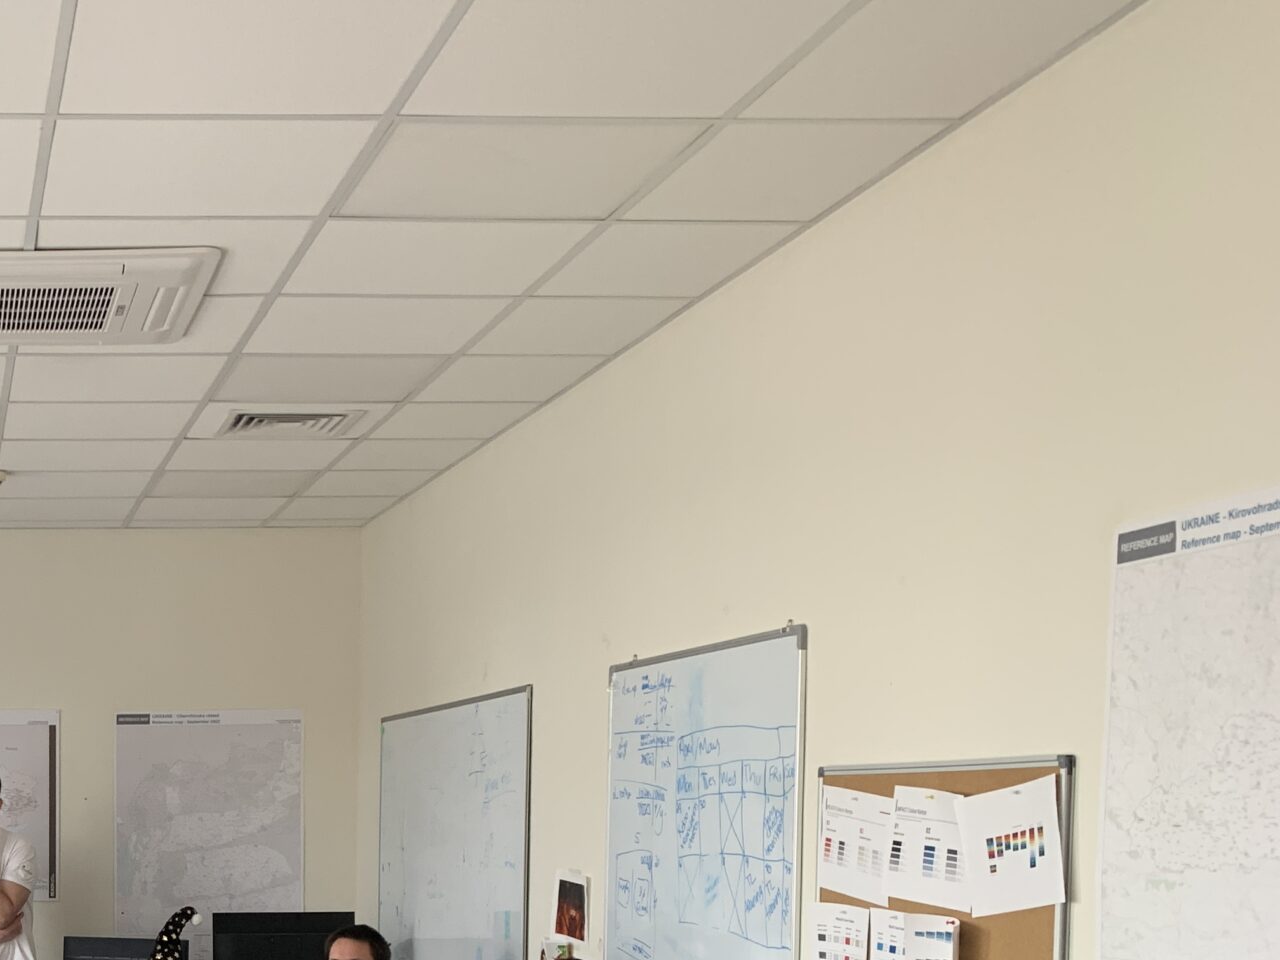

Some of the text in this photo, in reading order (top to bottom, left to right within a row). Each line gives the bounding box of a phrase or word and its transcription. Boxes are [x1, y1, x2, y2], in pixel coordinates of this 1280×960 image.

[1181, 512, 1220, 531] UKRAINE
[1120, 532, 1174, 552] REFERENCE MAP
[1181, 533, 1221, 551] Reference
[1223, 530, 1241, 543] map
